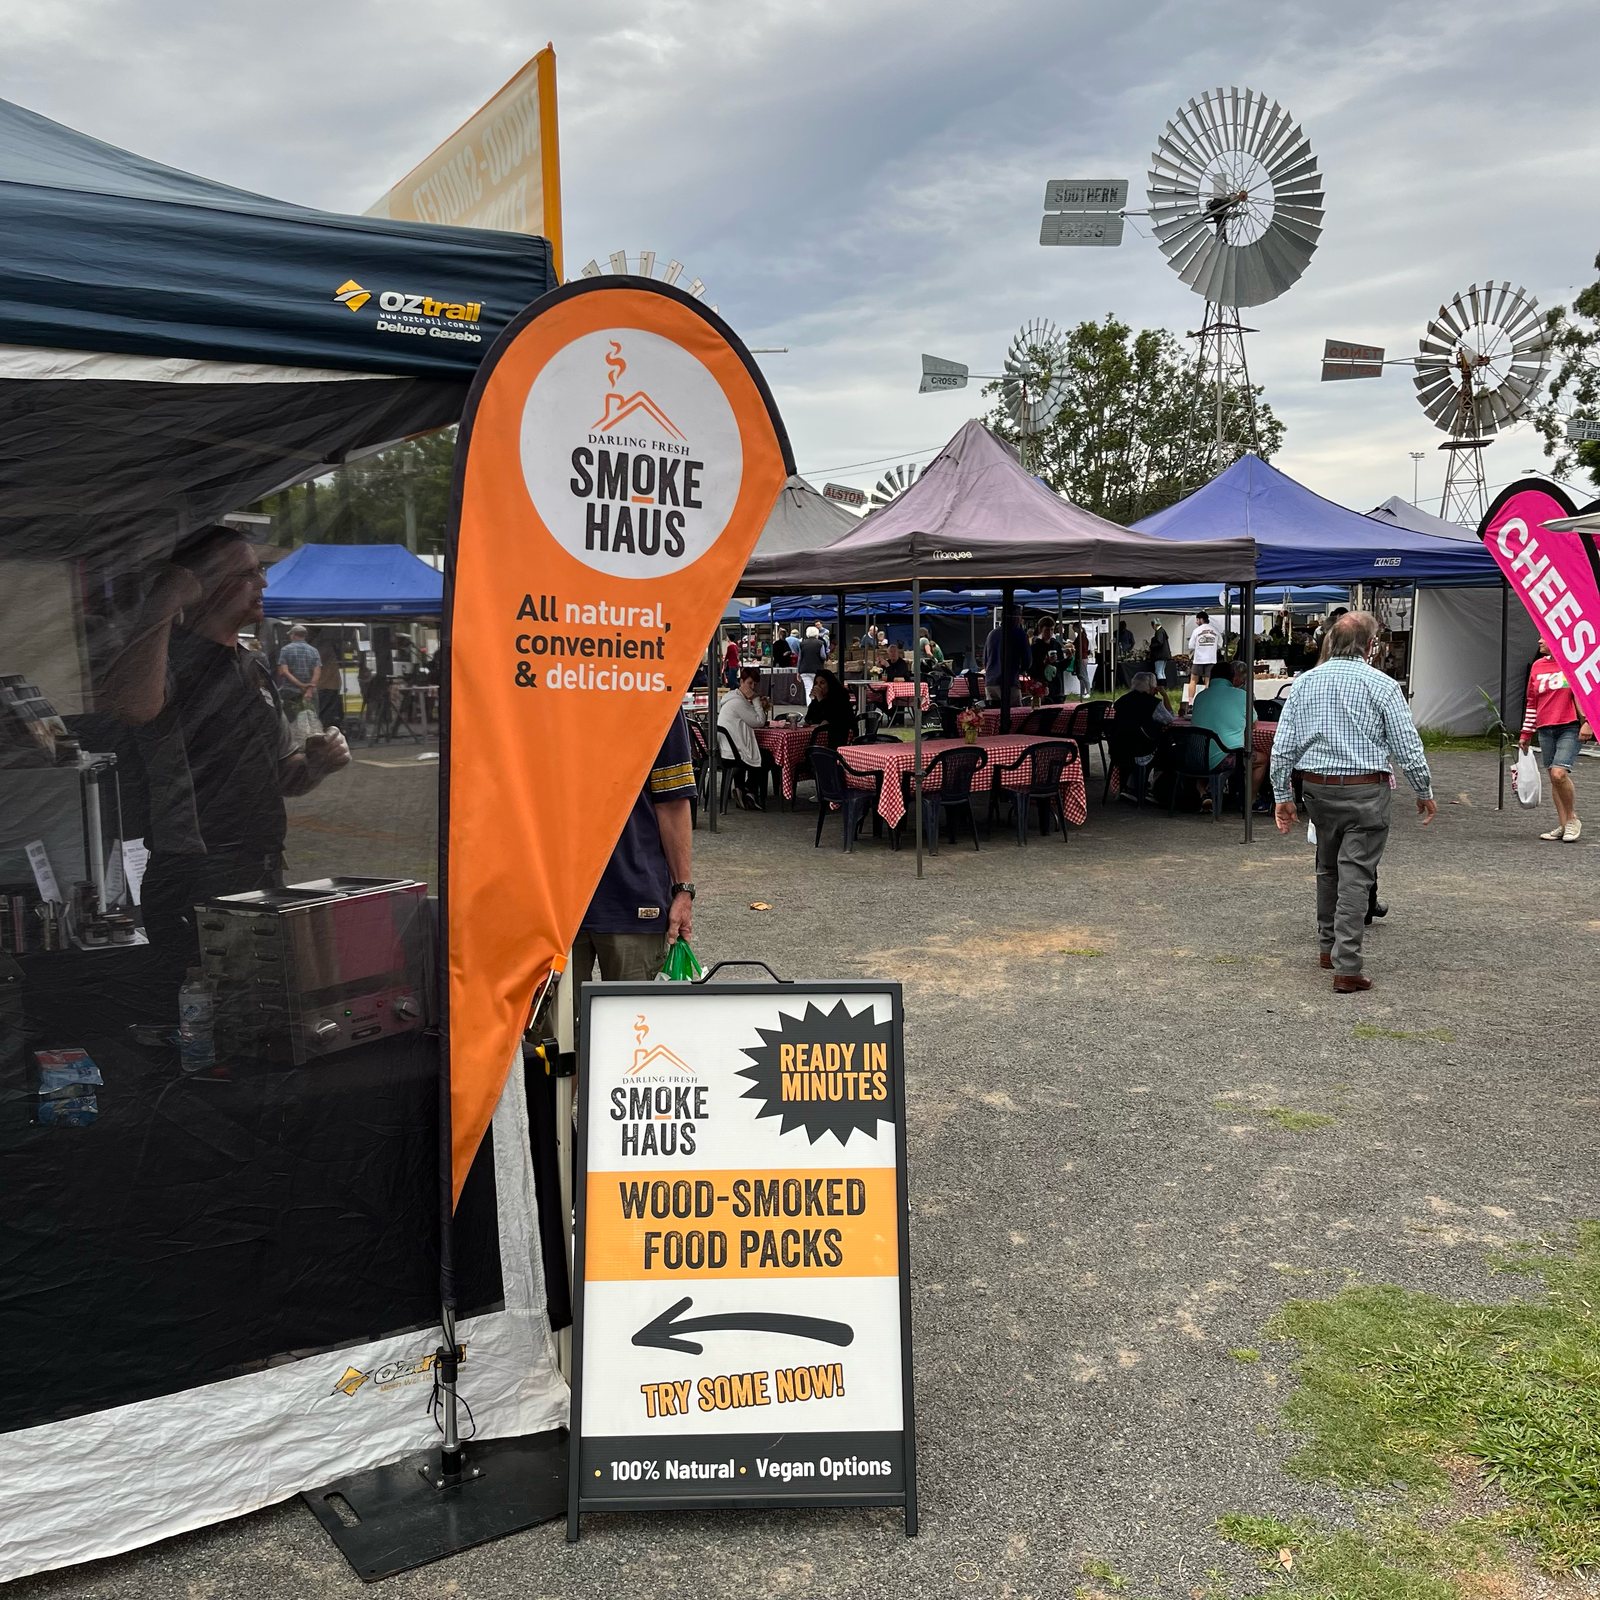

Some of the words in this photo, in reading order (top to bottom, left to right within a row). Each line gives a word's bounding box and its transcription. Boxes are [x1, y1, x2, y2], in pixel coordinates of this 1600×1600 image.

[1055, 187, 1118, 203] SOUTHERN
[376, 321, 426, 336] Deluxe
[429, 327, 482, 343] Gazebo
[380, 313, 480, 331] www.oztrail.com.au
[1329, 347, 1380, 360] COMET
[931, 376, 958, 386] CROSS
[588, 433, 646, 449] DARLING
[651, 439, 690, 457] FRESH
[570, 446, 704, 510] SMOKE
[825, 486, 864, 505] ALSTON
[585, 502, 686, 558] HAUS
[1374, 557, 1401, 567] KINGS
[516, 594, 558, 622] All
[565, 601, 671, 633] natural,
[1497, 517, 1600, 696] CHEESE
[515, 632, 665, 660] convenient
[515, 660, 537, 688] &
[546, 663, 672, 692] delicious.
[780, 1043, 856, 1072] READY
[863, 1042, 887, 1071] IN
[622, 1076, 665, 1085] DARLING
[669, 1076, 698, 1084] FRESH
[781, 1071, 888, 1102] MINUTES
[610, 1086, 709, 1121] SMOKE
[621, 1122, 696, 1156] HAUS
[619, 1178, 866, 1219] WOOD-SMOKED
[644, 1230, 728, 1270] FOOD
[740, 1228, 843, 1269] PACKS
[640, 1380, 692, 1418] TRY
[697, 1371, 771, 1412] SOME
[775, 1363, 845, 1403] NOW!
[610, 1460, 660, 1481] 100%
[665, 1458, 735, 1480] Natural
[755, 1458, 815, 1483] Vegan
[819, 1455, 892, 1482] Options
